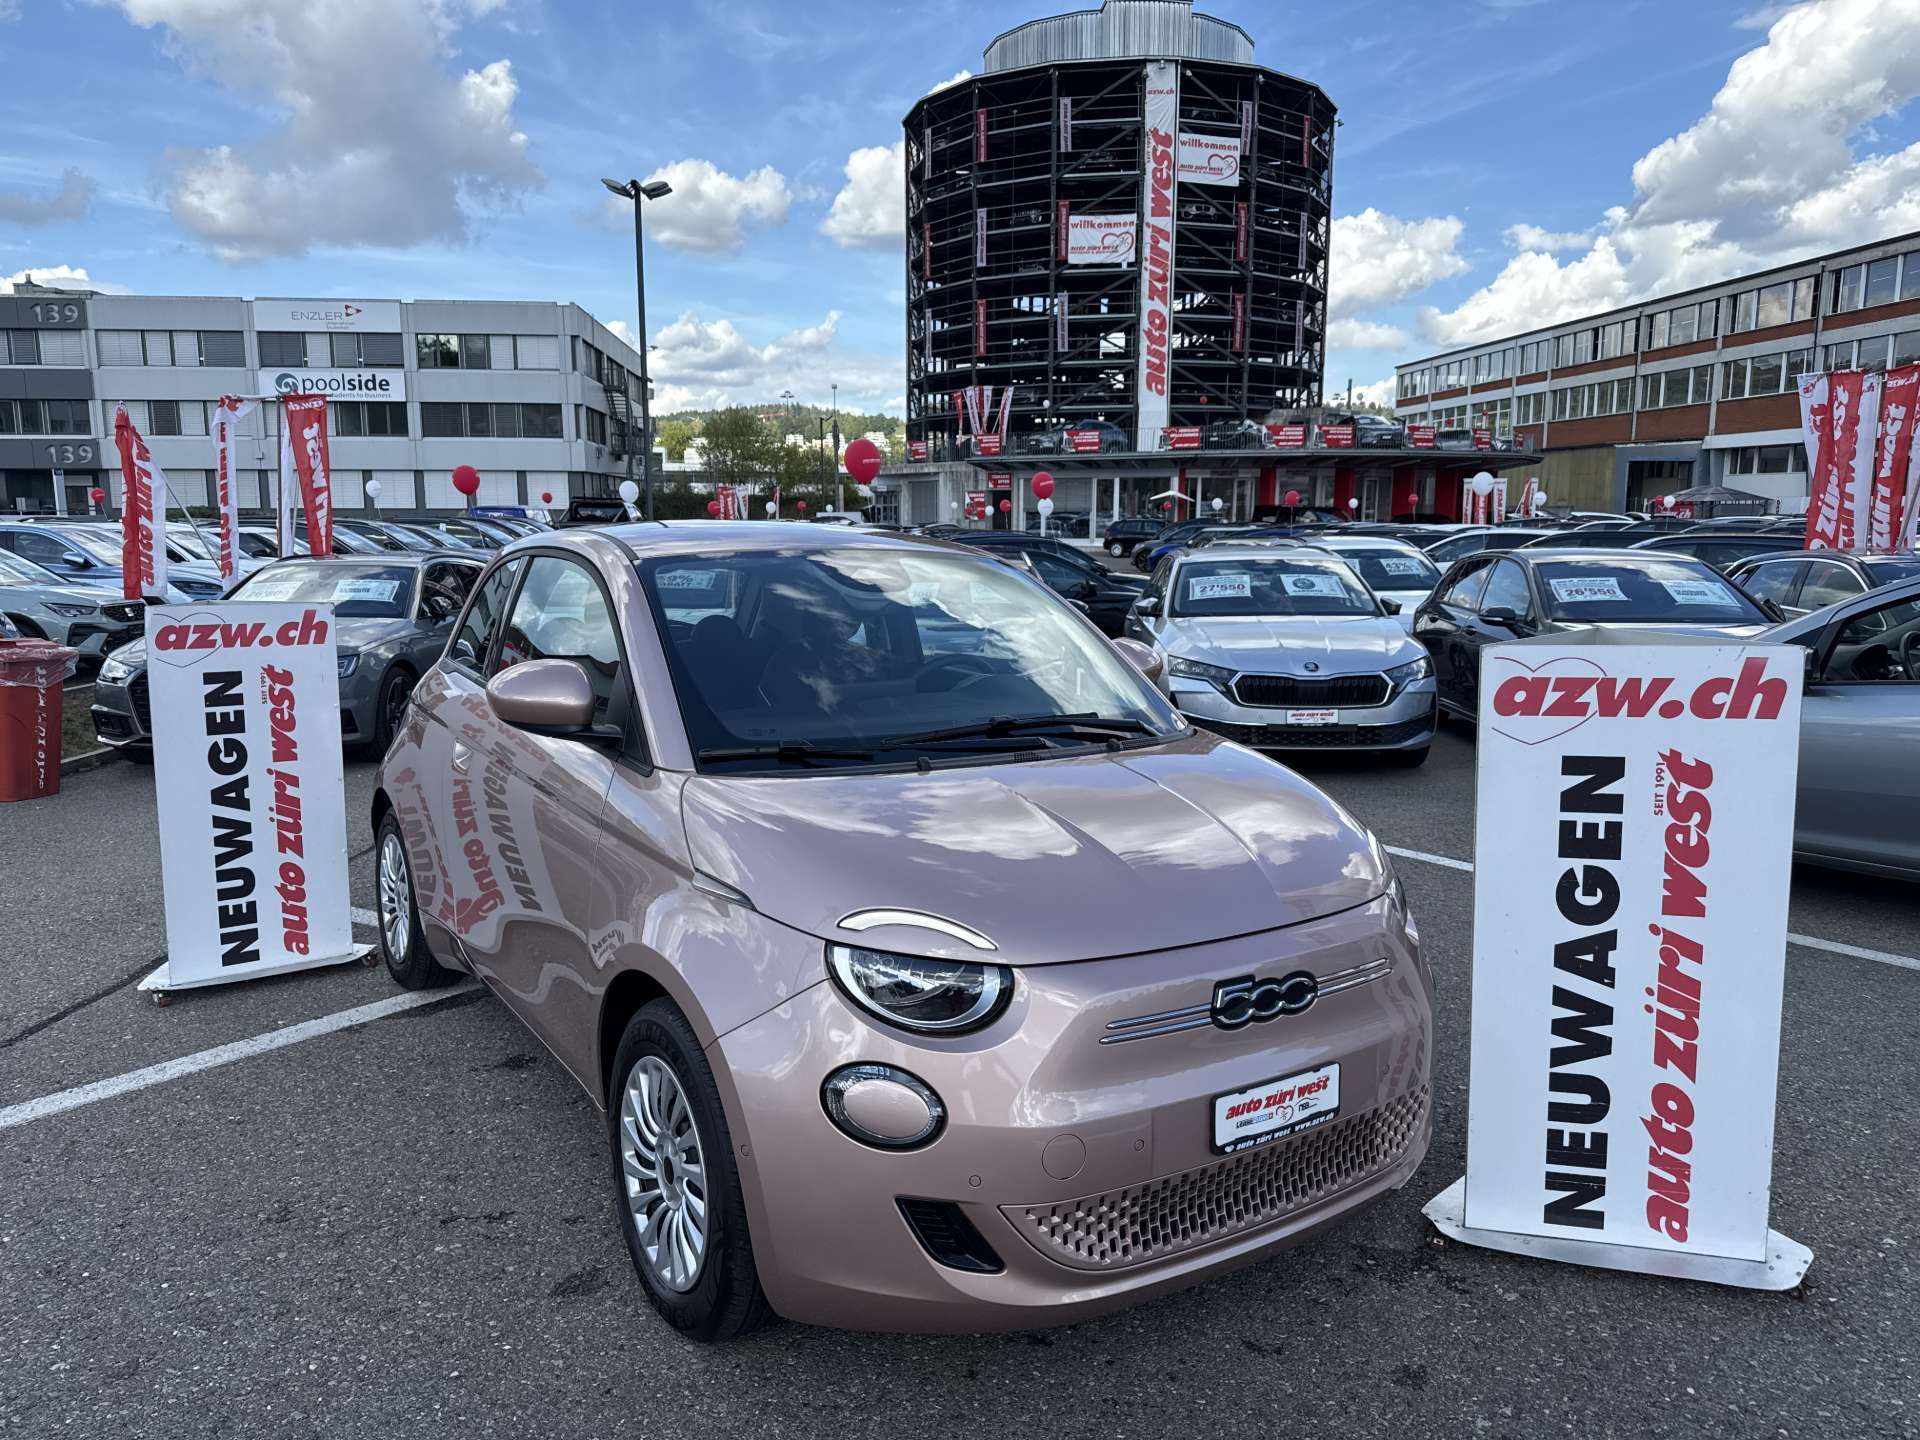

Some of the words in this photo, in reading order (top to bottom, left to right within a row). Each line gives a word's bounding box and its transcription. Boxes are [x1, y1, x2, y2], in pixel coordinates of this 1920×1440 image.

[1150, 127, 1174, 218] west
[1180, 138, 1239, 152] willkommen
[1071, 219, 1135, 229] willkommen
[1143, 221, 1171, 308] züri
[31, 303, 79, 323] 139
[291, 311, 343, 321] ENZLER
[1143, 309, 1167, 397] auto
[302, 373, 391, 393] poolside
[46, 445, 93, 463] 139
[154, 609, 329, 652] azw.ch
[262, 664, 297, 763] west
[1493, 656, 1788, 720] azw.ch
[1654, 789, 1664, 817] SEIT
[1655, 761, 1665, 786] 1991
[203, 670, 261, 967] NEUWAGEN
[266, 768, 304, 859] züri
[1659, 747, 1714, 918] west
[273, 861, 310, 956] auto
[1214, 973, 1316, 1028] 500
[1543, 755, 1626, 1230] NEUWAGEN
[1643, 923, 1704, 1085] züri
[1226, 1097, 1263, 1120] auto
[1263, 1085, 1297, 1110] züri
[1298, 1076, 1330, 1098] west
[1236, 1139, 1255, 1150] auto
[1256, 1132, 1273, 1144] züri
[1274, 1127, 1292, 1138] west
[1639, 1083, 1696, 1243] auto
